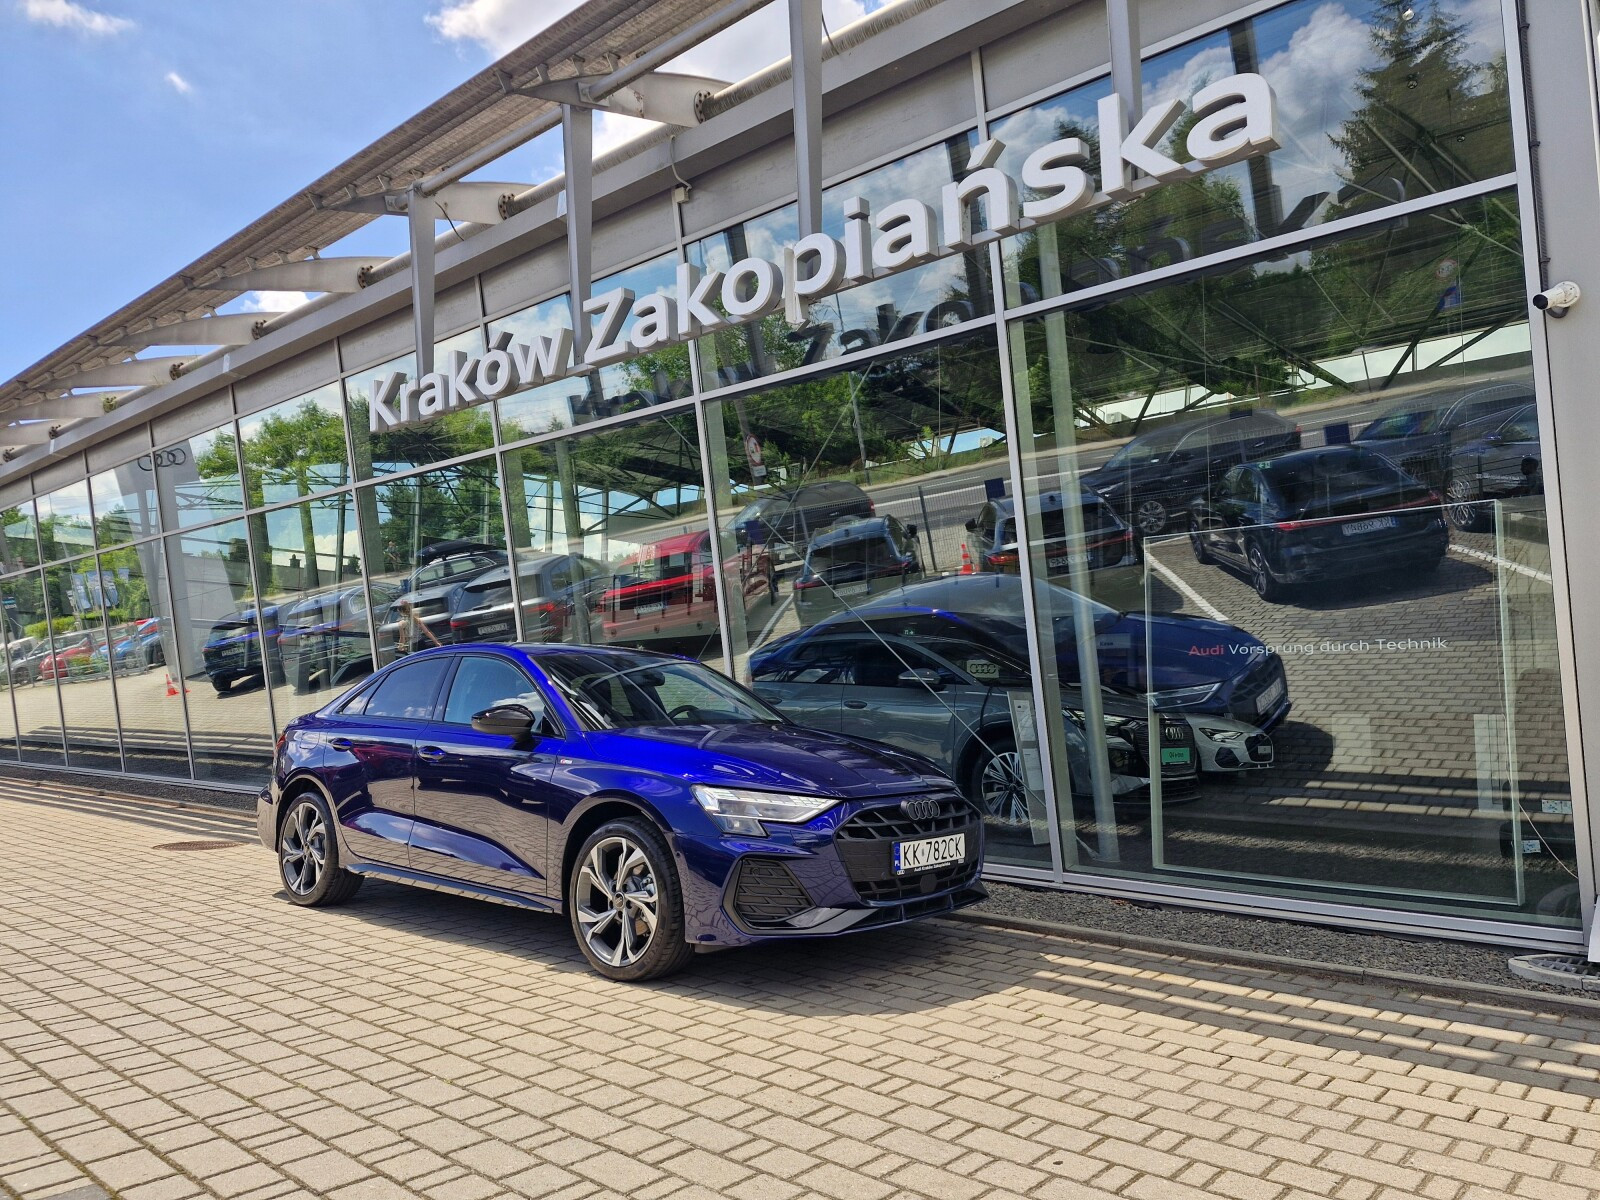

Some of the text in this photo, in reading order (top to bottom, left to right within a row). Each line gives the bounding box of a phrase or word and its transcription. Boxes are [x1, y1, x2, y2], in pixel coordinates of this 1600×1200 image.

[368, 71, 1282, 434] Kraków Zakopiańska
[1188, 636, 1449, 657] Audi Vorsprung durch Technik
[903, 836, 962, 867] KK 782CK
